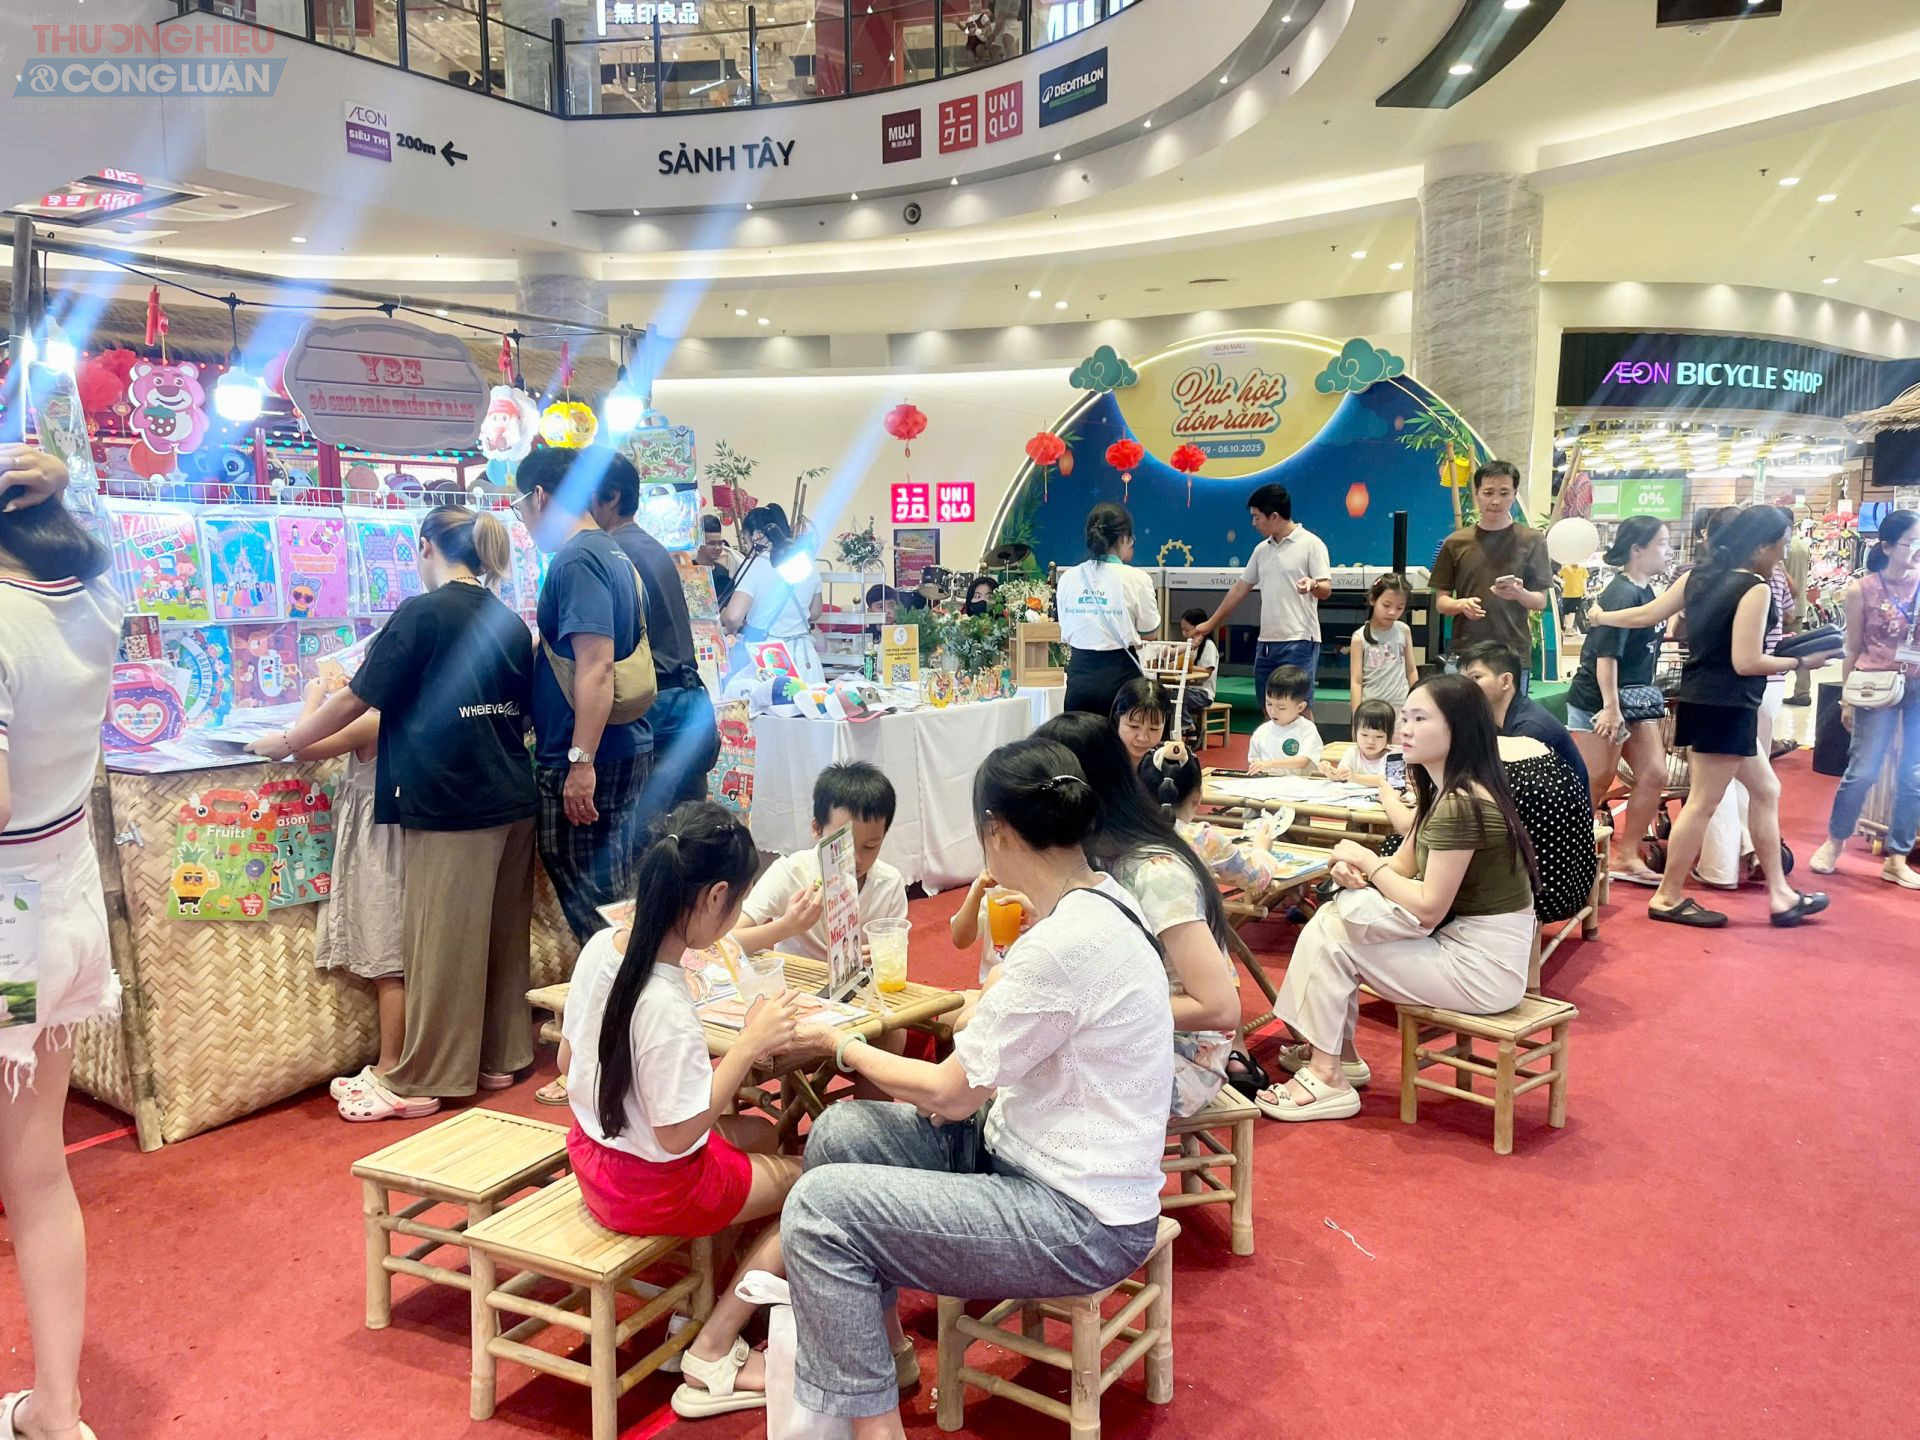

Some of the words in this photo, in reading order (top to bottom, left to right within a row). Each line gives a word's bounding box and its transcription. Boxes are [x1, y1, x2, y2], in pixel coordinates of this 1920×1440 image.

[1054, 66, 1104, 98] DECATHLON
[988, 89, 1016, 114] UNI
[888, 124, 915, 142] MUJI
[989, 116, 1018, 137] QLO
[349, 129, 370, 142] SIÊU
[372, 134, 389, 149] THỊ
[396, 133, 436, 155] 200m
[658, 142, 735, 175] SẢNH
[742, 136, 795, 169] TÂY
[357, 354, 424, 386] YBE
[1677, 361, 1778, 390] BICYCLE
[1782, 369, 1823, 394] SHOP
[1176, 368, 1231, 406] Vui
[1236, 373, 1279, 407] hội
[1176, 404, 1222, 433] đón
[1223, 402, 1274, 430] rằm
[1218, 444, 1261, 453] 06.10.2025
[940, 487, 969, 502] UNI
[1638, 492, 1665, 505] 0%
[940, 503, 971, 520] QLO
[246, 908, 257, 916] 26
